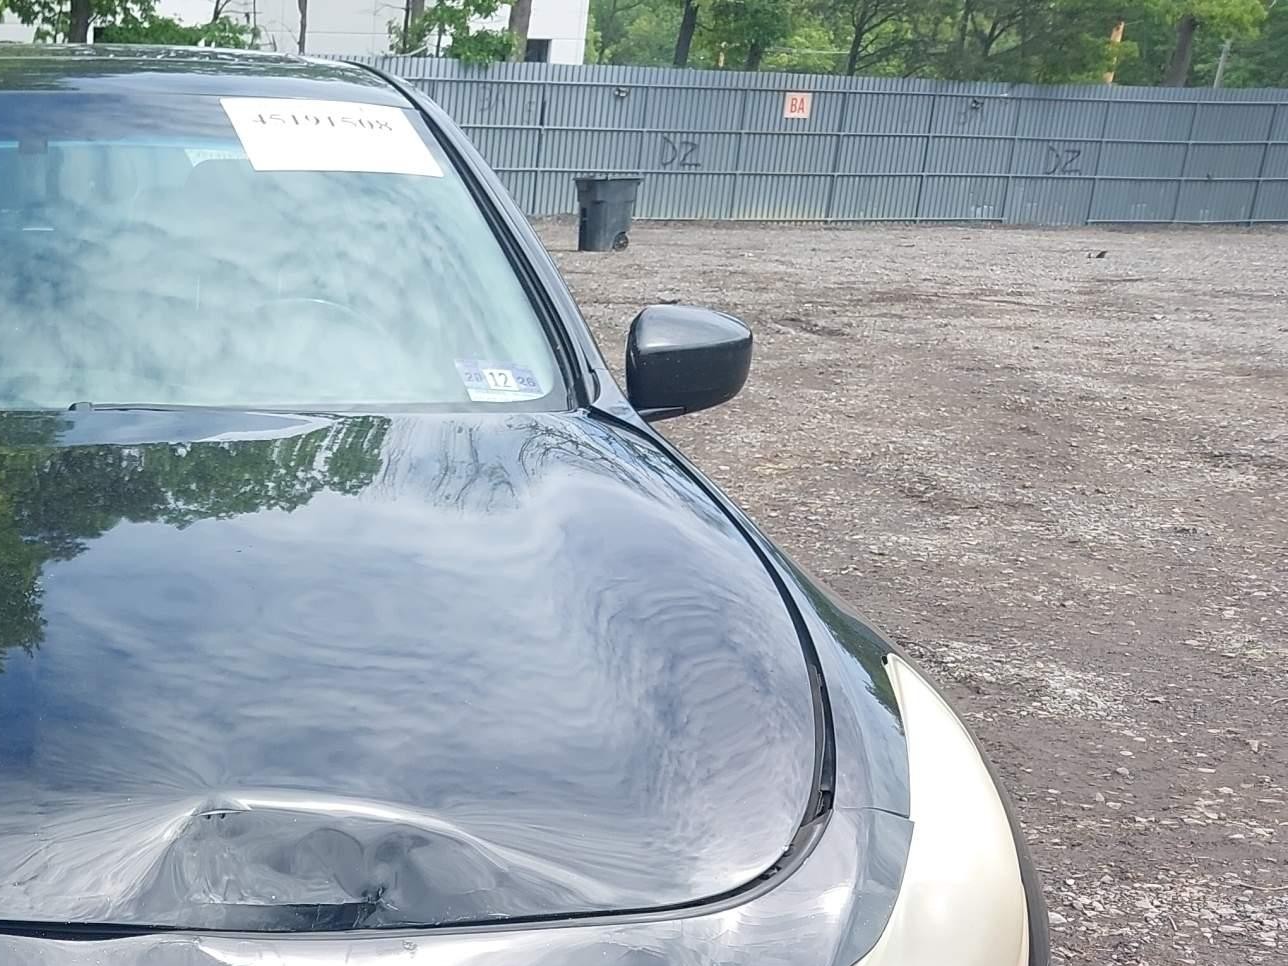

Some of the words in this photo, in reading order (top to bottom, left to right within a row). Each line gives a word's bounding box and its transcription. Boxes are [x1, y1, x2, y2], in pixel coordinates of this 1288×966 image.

[789, 97, 806, 114] BA
[661, 134, 702, 167] DZ
[1045, 144, 1083, 176] DZ
[488, 371, 513, 388] 12
